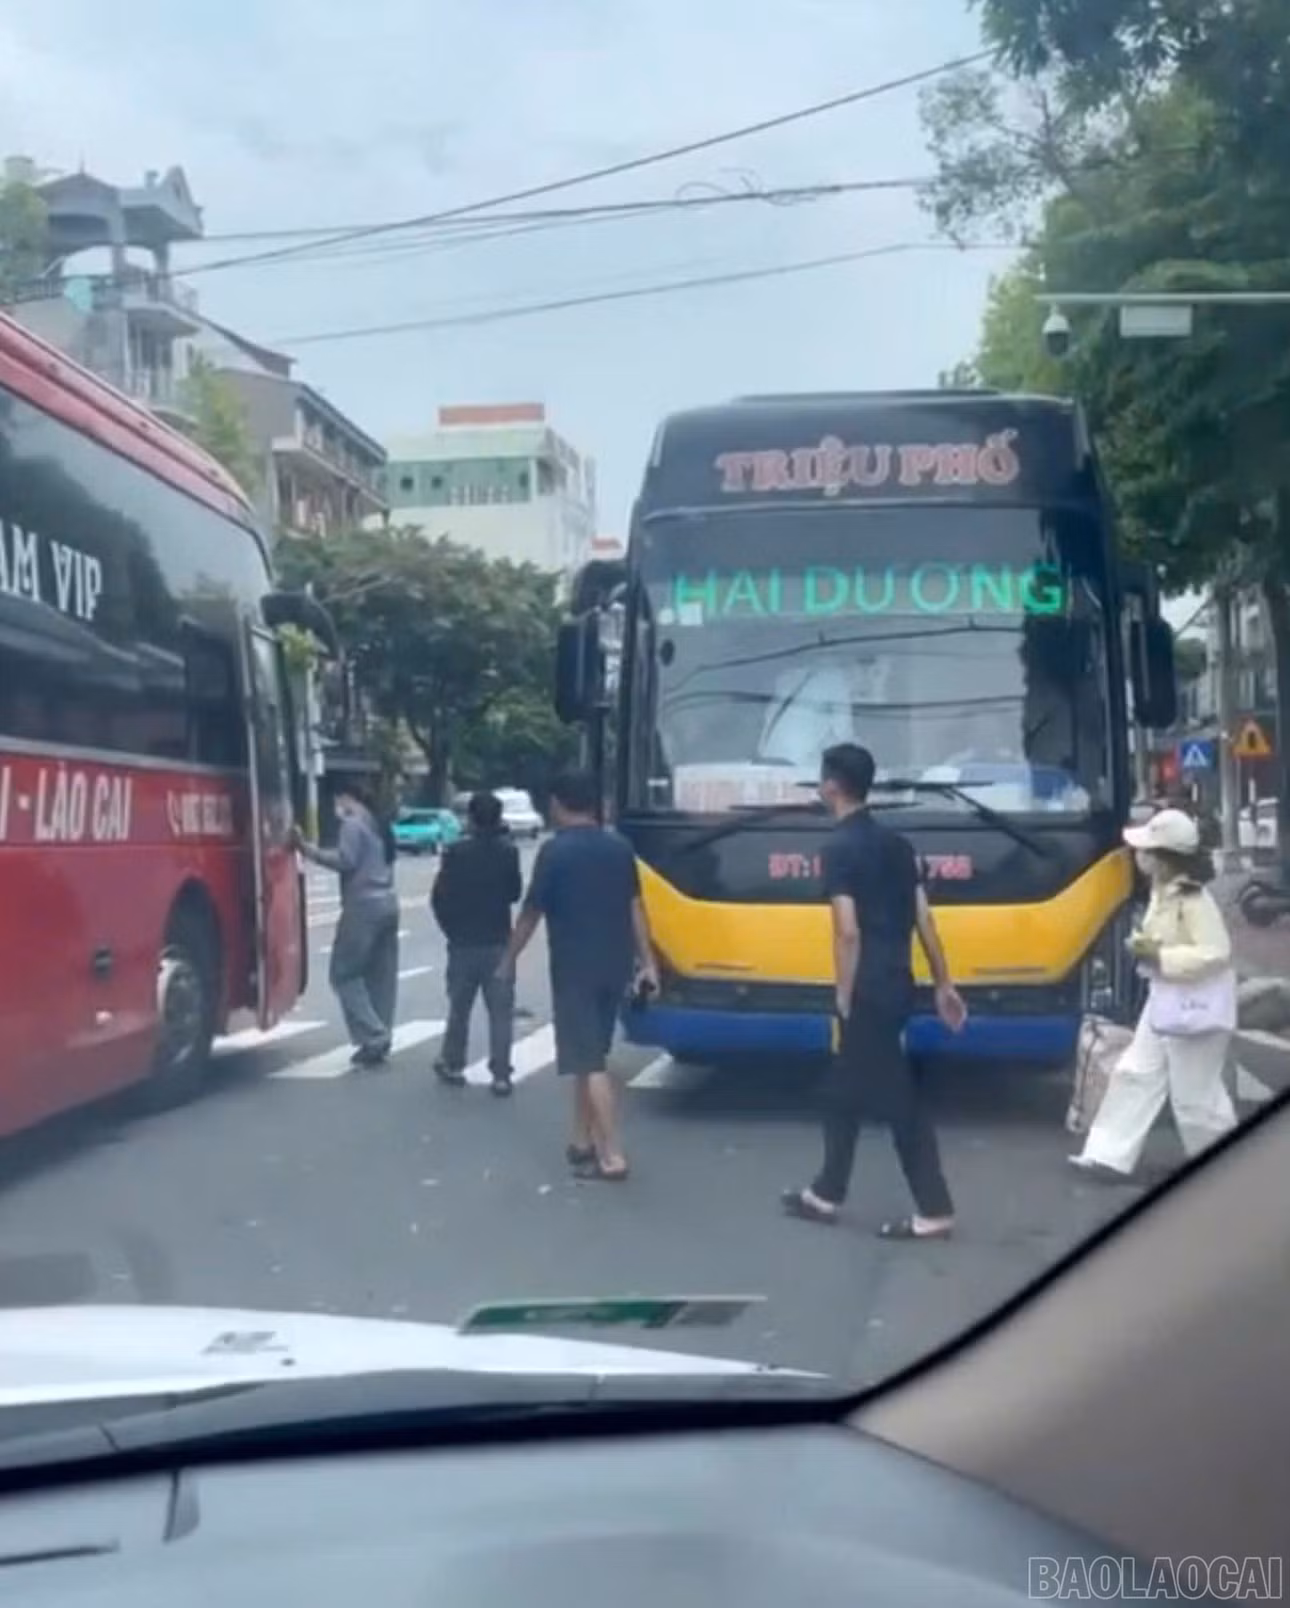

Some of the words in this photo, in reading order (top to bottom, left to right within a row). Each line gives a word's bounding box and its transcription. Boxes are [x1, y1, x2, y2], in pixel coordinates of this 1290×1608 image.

[715, 435, 892, 497] TRIỆU
[898, 428, 1020, 486] PHỐ
[50, 539, 102, 620] VIP
[92, 772, 132, 841] CAI
